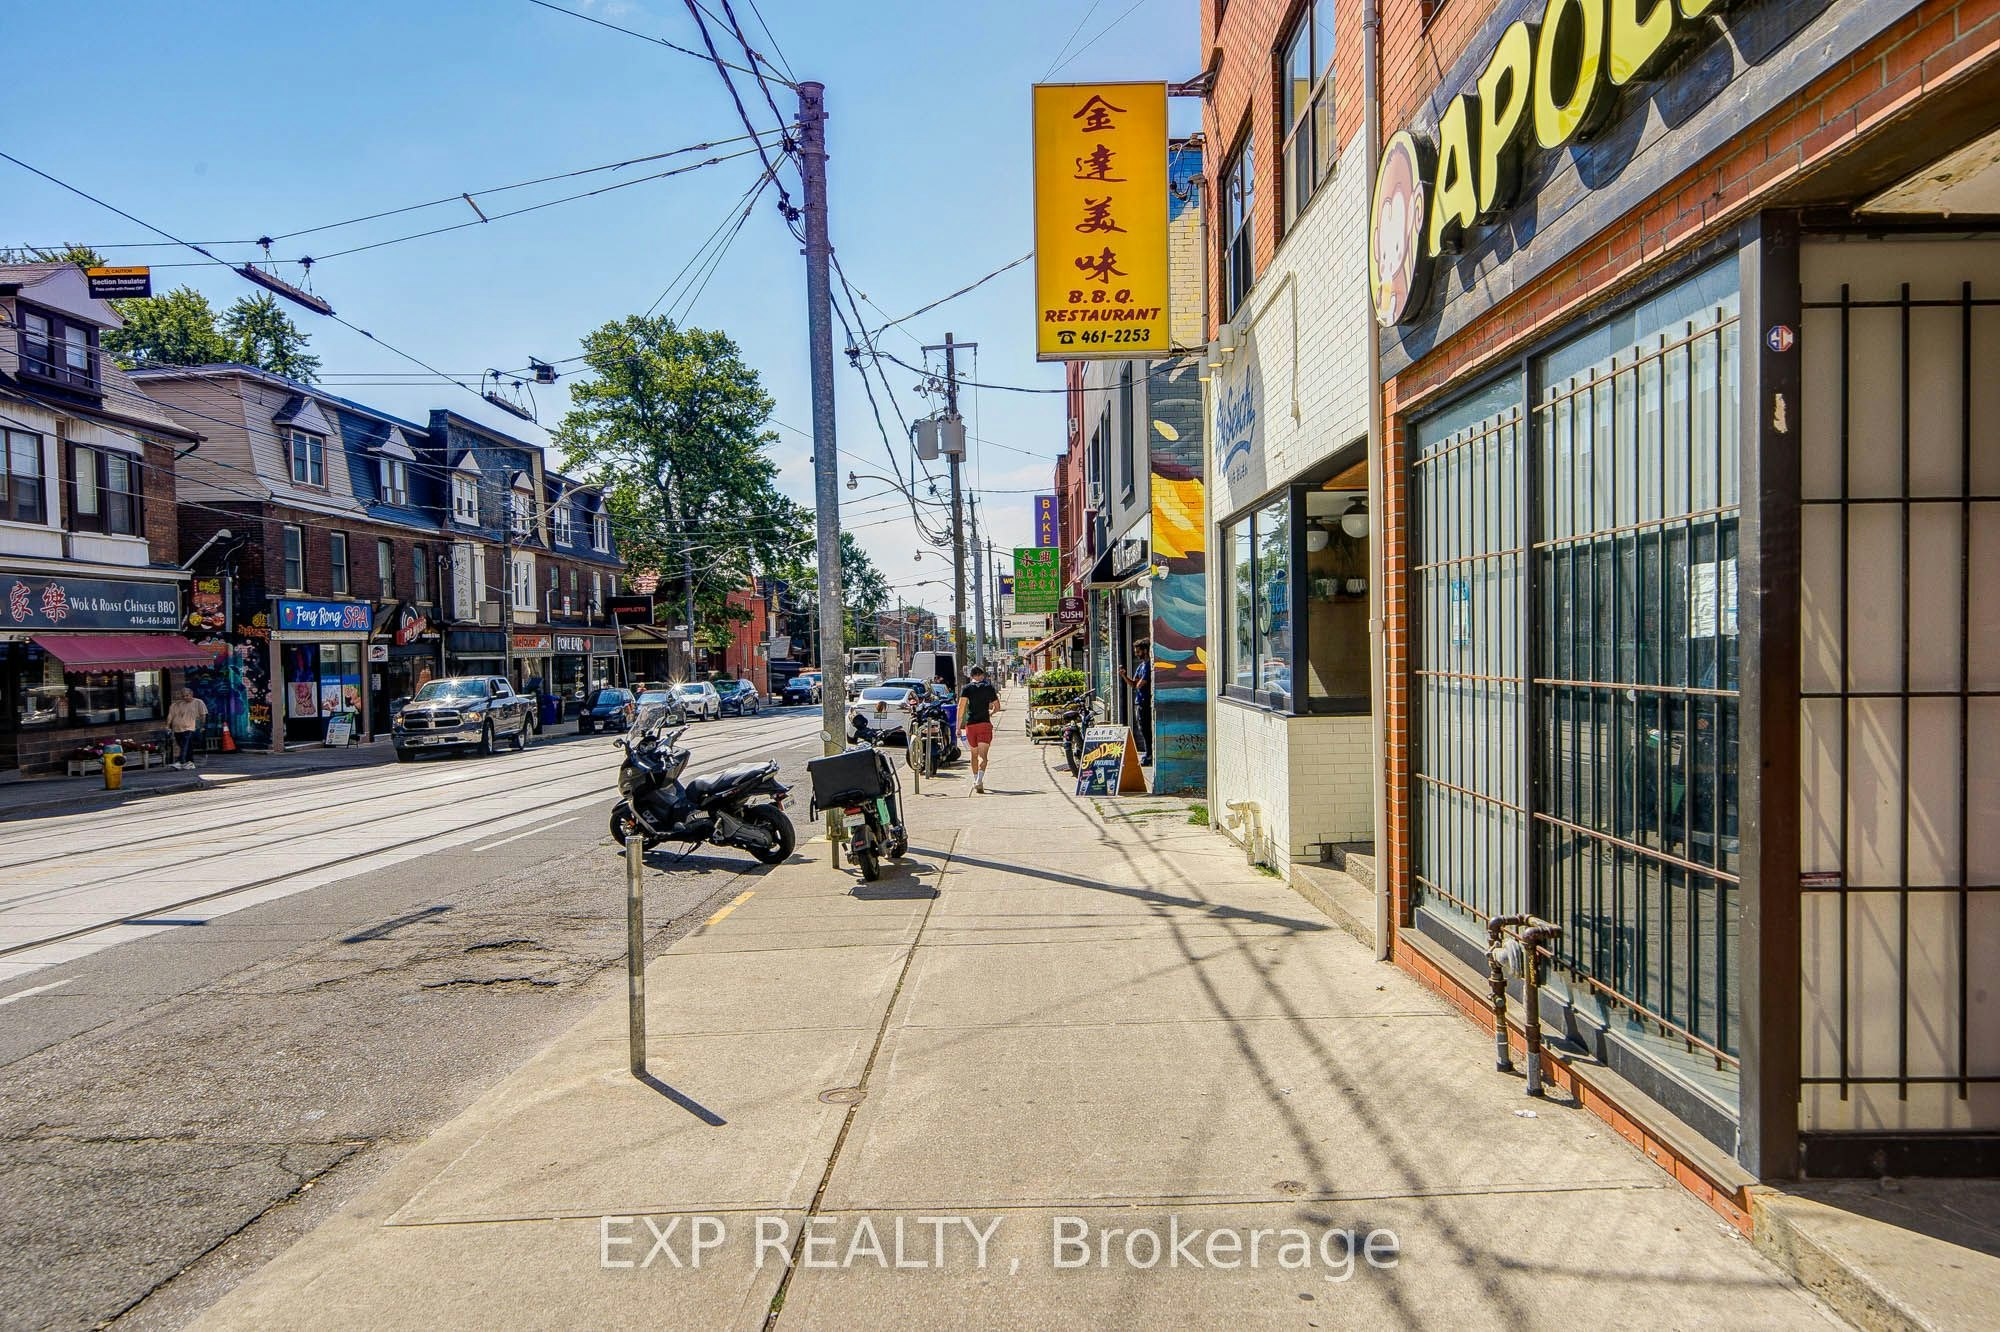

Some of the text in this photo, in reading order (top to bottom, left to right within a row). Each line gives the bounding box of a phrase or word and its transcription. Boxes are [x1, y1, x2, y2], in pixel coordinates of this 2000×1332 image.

[1073, 95, 1128, 284] 金達美味
[92, 278, 117, 286] Section
[1068, 289, 1134, 304] B.B.Q.
[1044, 307, 1161, 323] RESTAURANT
[1081, 328, 1150, 344] 461-2253
[1042, 499, 1051, 548] BAKE
[70, 597, 89, 611] Wok
[91, 597, 98, 611] &
[100, 598, 122, 612] ROAST
[158, 600, 175, 614] BBQ
[130, 616, 176, 625] 416-461-3811
[296, 605, 369, 629] Feng Rong SPA
[1060, 611, 1083, 619] SUSHI
